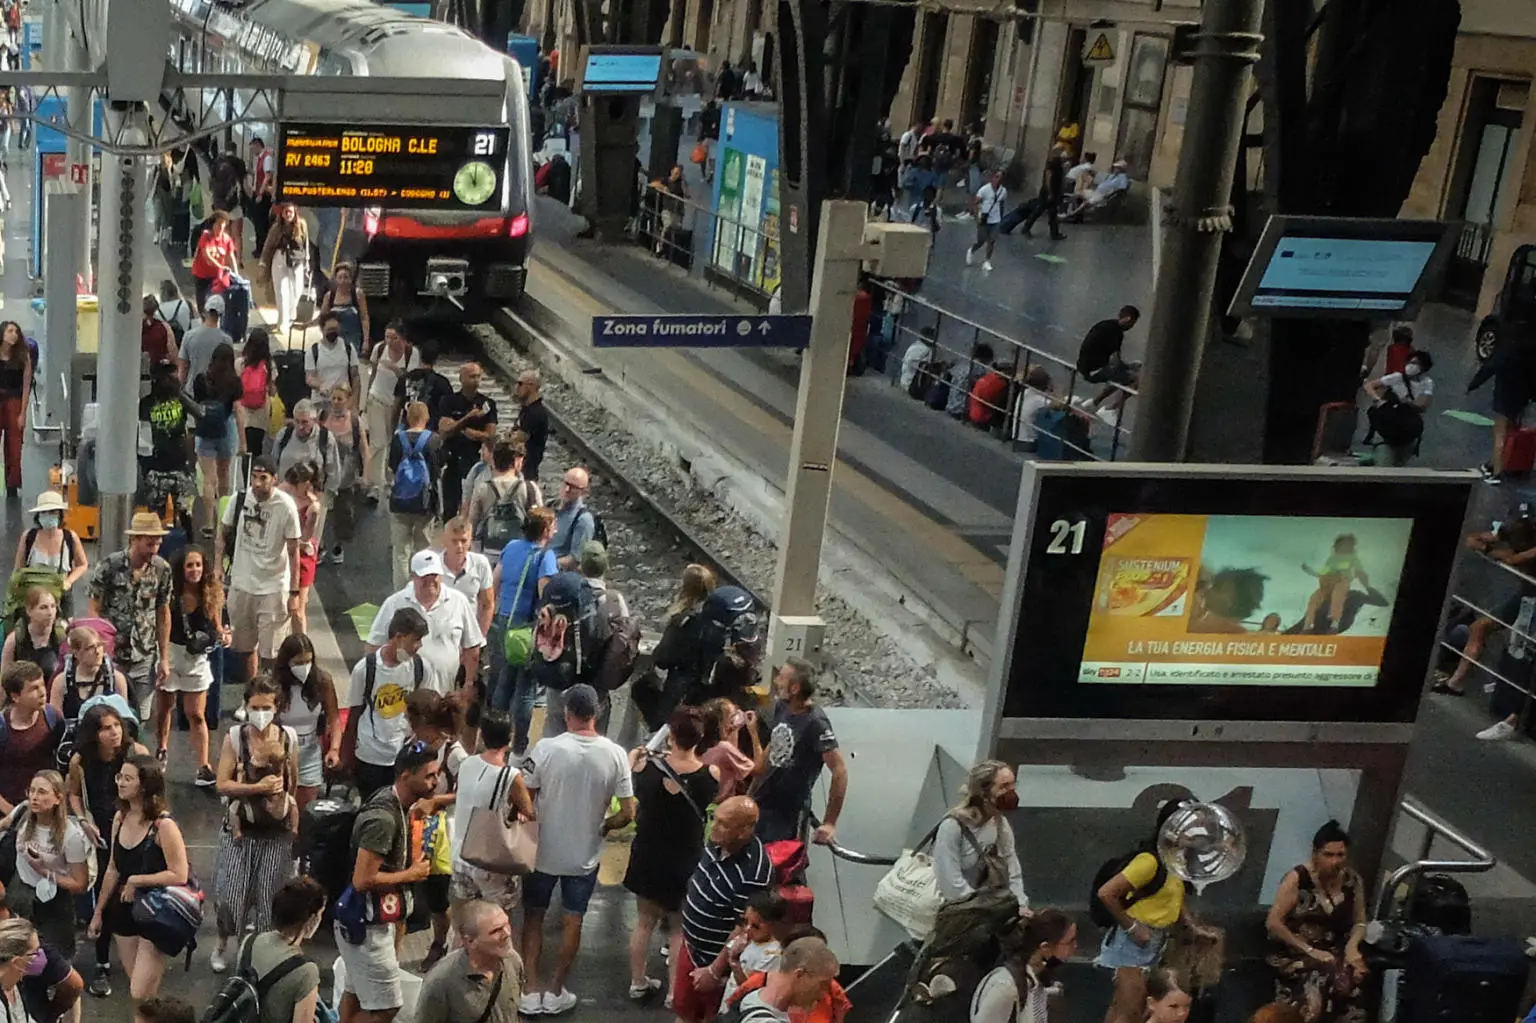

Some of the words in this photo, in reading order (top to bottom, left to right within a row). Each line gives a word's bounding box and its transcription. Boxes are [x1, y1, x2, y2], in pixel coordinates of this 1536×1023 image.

[341, 137, 400, 153] BOLOGNA
[408, 138, 438, 154] C.LE
[474, 134, 495, 155] 21
[285, 153, 302, 166] RV
[339, 160, 373, 175] 11:20
[603, 320, 647, 335] Zona
[652, 319, 726, 336] fumatori
[1046, 520, 1086, 554] 21
[785, 638, 803, 652] 21
[1128, 641, 1143, 654] LA
[1147, 641, 1170, 655] TUA
[1172, 641, 1223, 656] ENERGIA
[1226, 642, 1265, 656] FISICA
[1267, 643, 1277, 656] E
[1278, 643, 1337, 657] MENTALE!
[1170, 669, 1221, 678] identificato
[1230, 671, 1271, 679] arrestato
[1272, 672, 1313, 681] presunto
[1314, 672, 1362, 681] aggressore
[382, 893, 398, 915] 8
